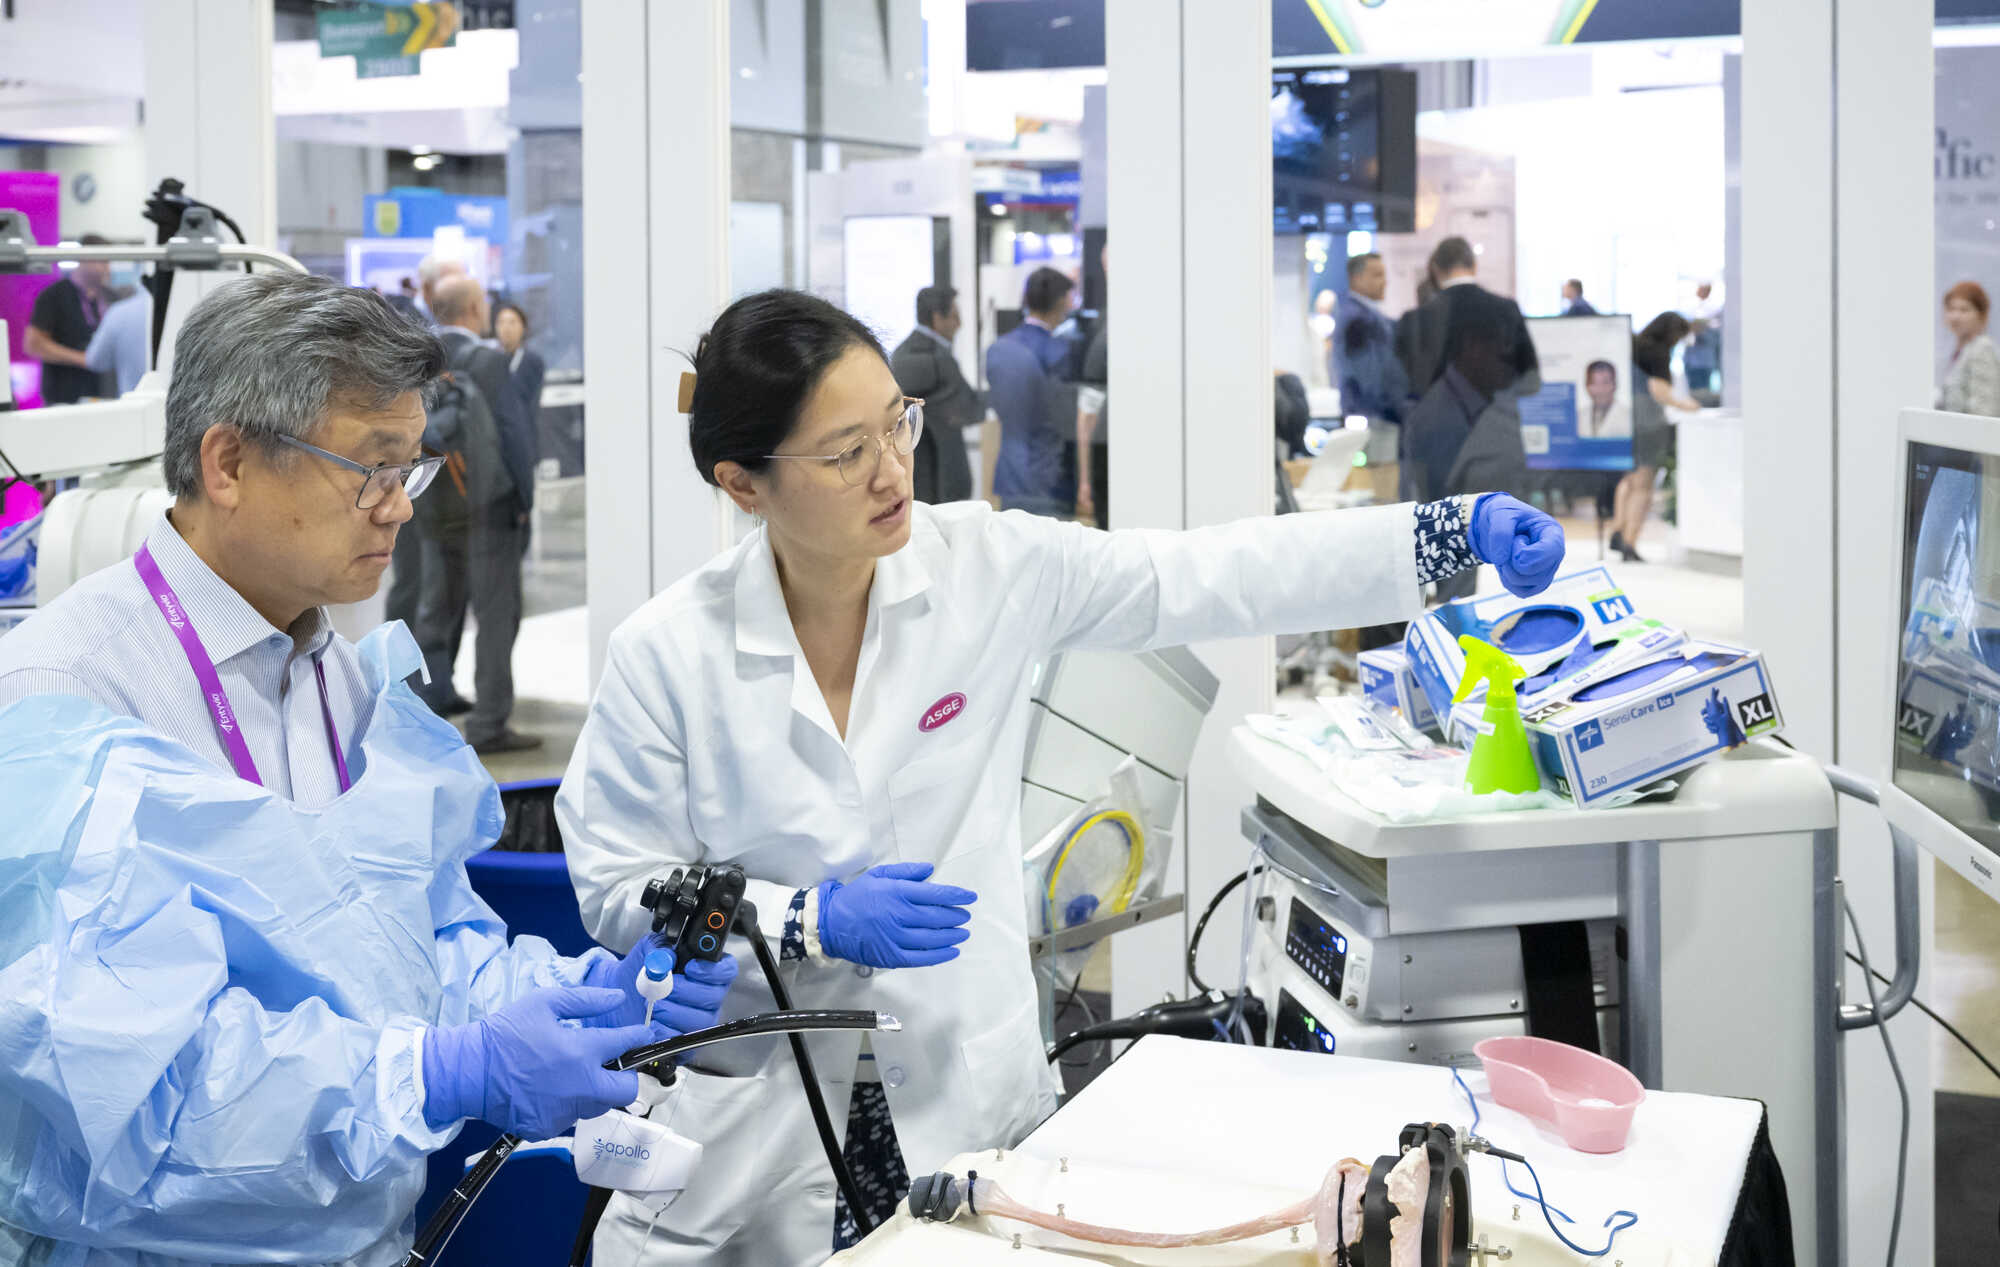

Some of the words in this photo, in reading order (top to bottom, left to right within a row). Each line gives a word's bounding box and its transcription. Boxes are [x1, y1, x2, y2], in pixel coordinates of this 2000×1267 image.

[212, 693, 231, 729] Entyvio
[926, 698, 961, 727] ASGE
[1527, 701, 1568, 722] XL
[1603, 703, 1655, 730] SensiCare
[1742, 699, 1774, 727] XL
[605, 1140, 649, 1160] apollo
